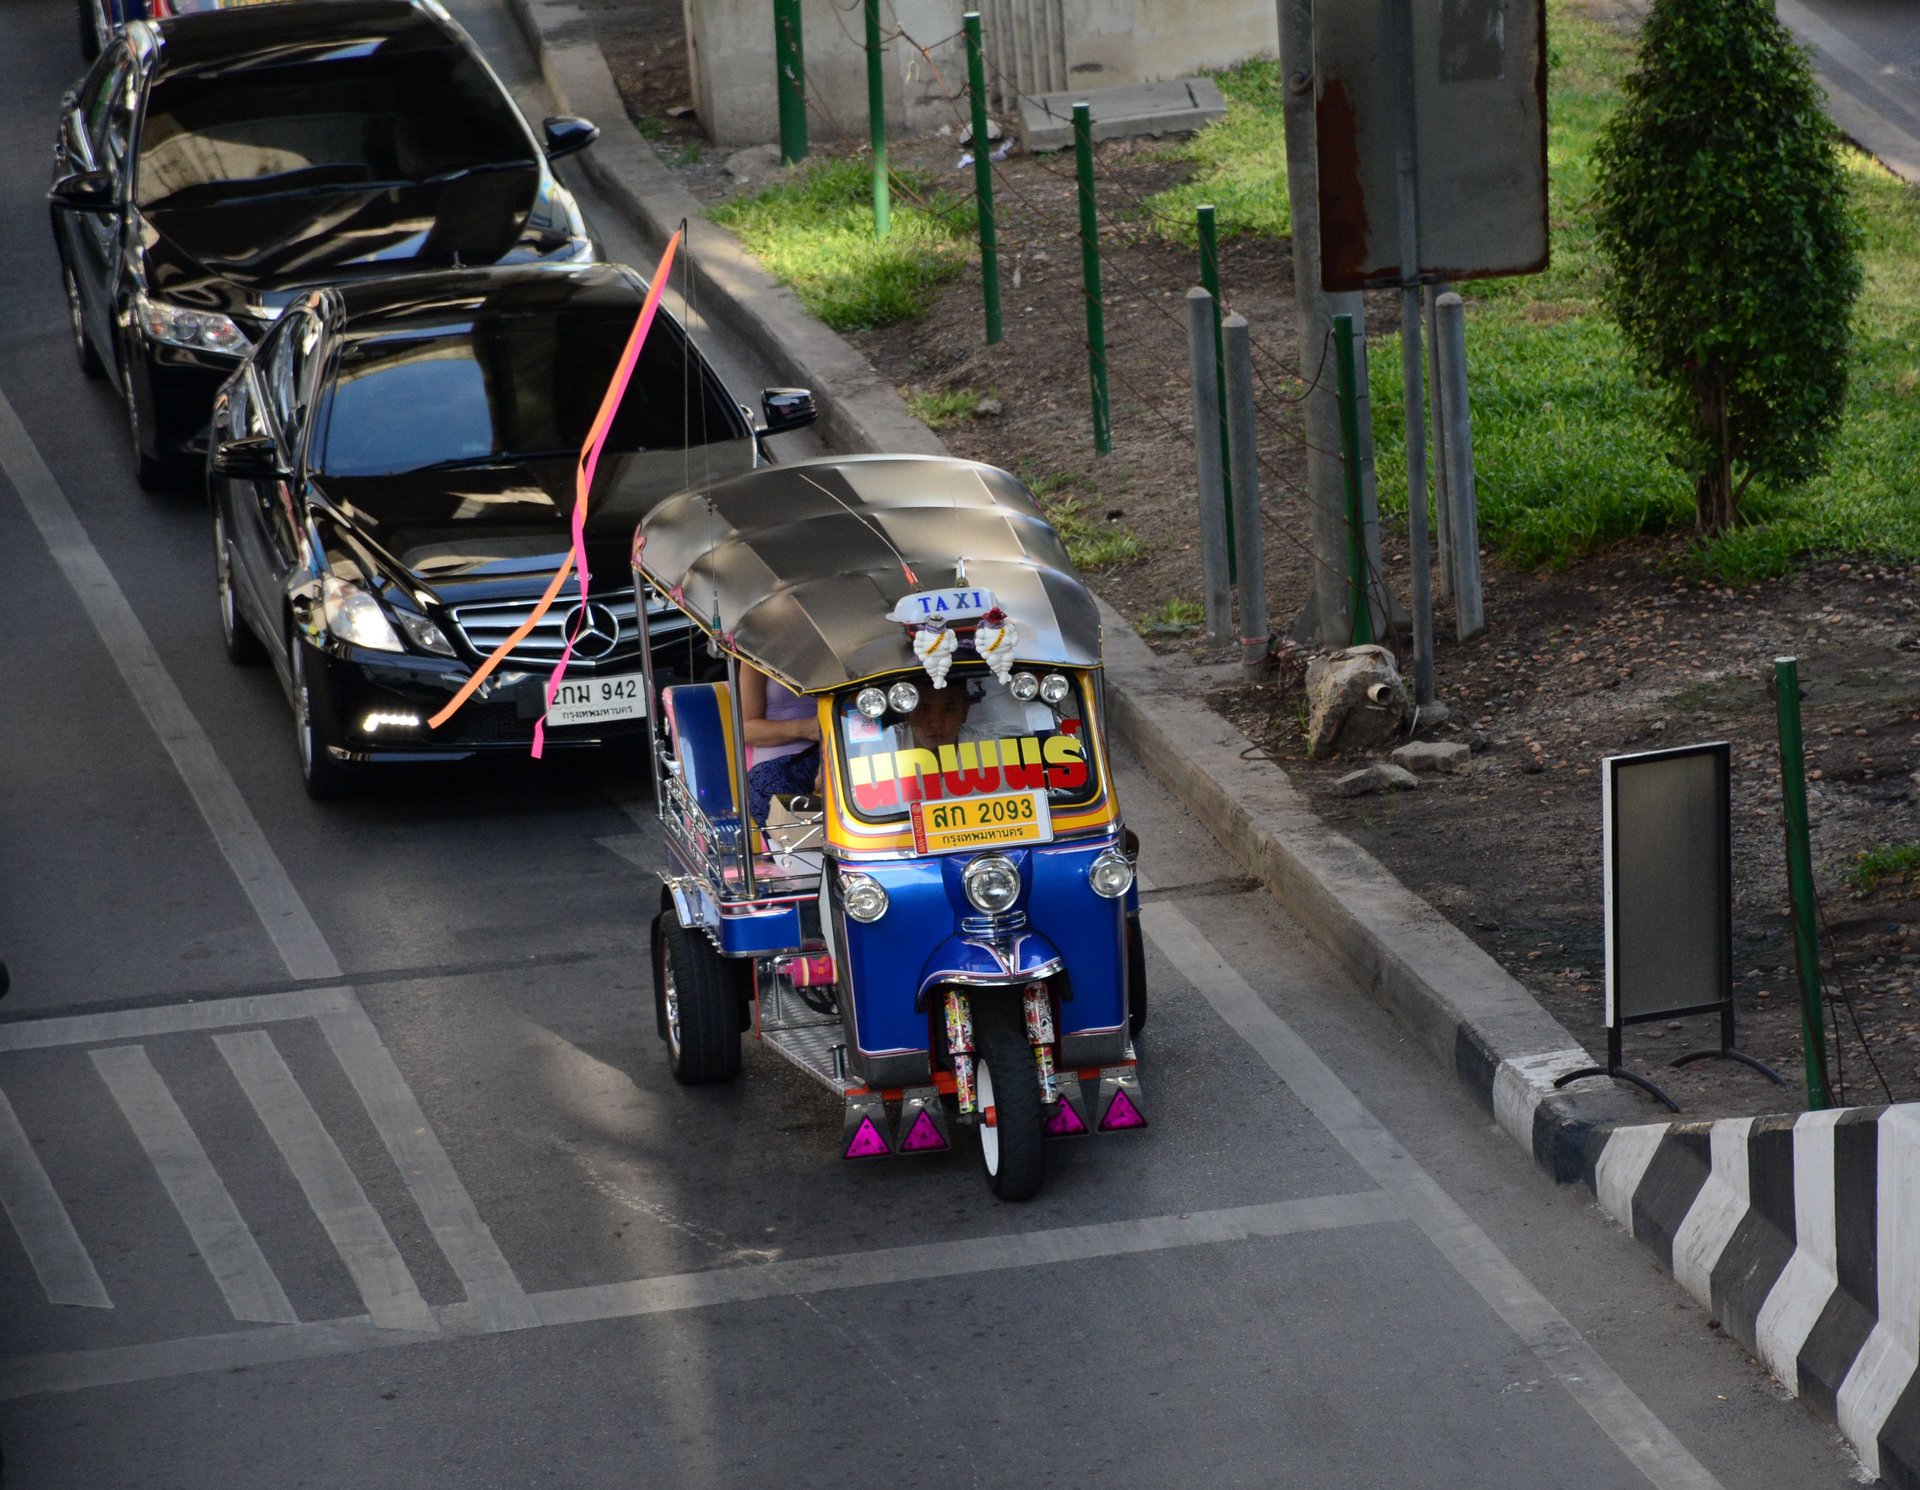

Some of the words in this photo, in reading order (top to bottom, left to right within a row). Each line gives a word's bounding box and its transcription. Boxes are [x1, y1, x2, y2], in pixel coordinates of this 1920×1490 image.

[918, 592, 982, 613] TAXI
[601, 680, 637, 700] 942
[562, 705, 633, 721] กรุงเทพมหานคร
[932, 805, 966, 828] สก
[978, 798, 1033, 824] 2093
[942, 827, 1023, 846] กรุงเทพมหานคร
